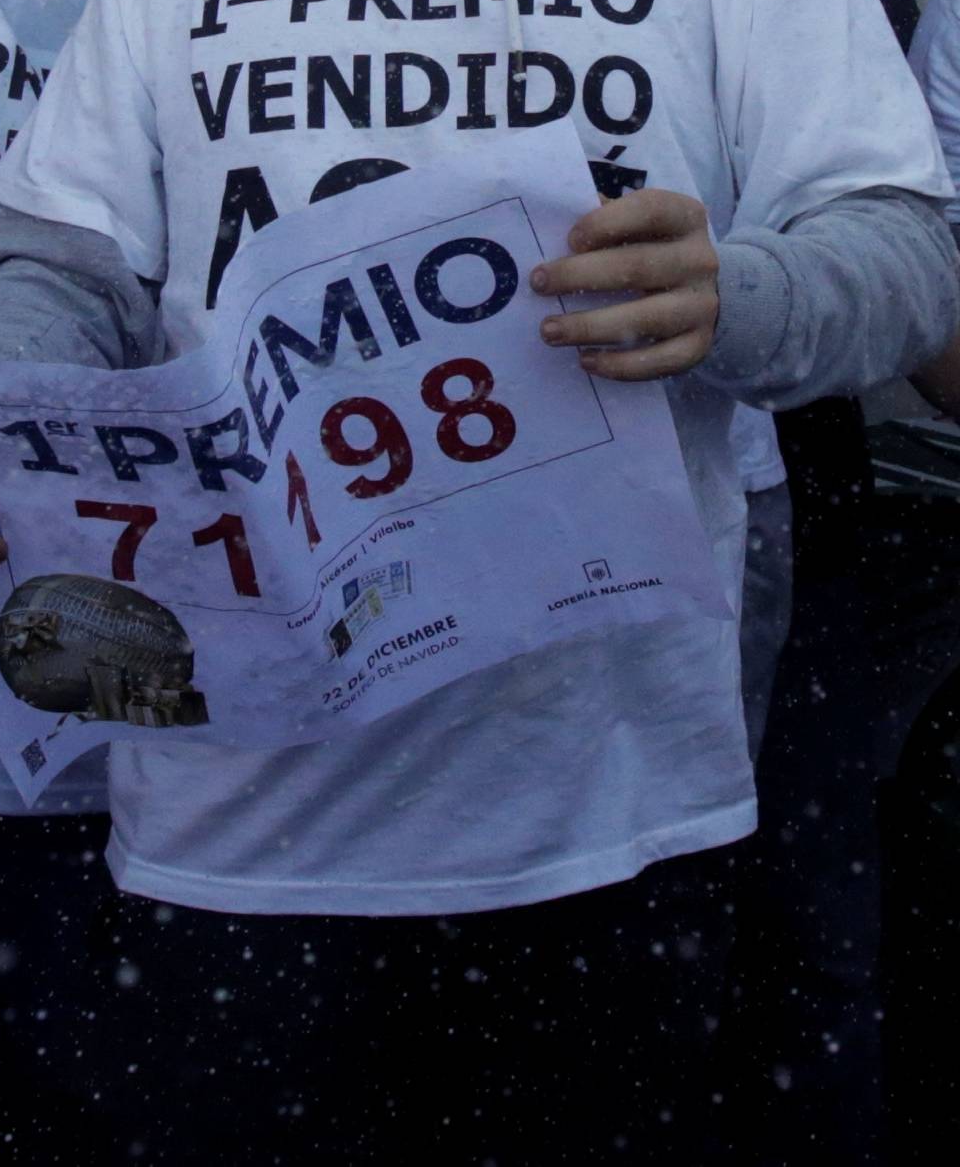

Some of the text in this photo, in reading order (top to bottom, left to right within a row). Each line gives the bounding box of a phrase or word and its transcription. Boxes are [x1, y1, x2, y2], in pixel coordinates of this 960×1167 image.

[190, 50, 654, 142] VENDIDO
[92, 236, 520, 492] PREMIO
[369, 518, 416, 545] Vilalba
[547, 577, 664, 612] LOTERÍA NACIONAL
[347, 667, 368, 691] DE
[366, 614, 459, 670] DICIEMBRE
[377, 663, 395, 679] DE
[397, 635, 460, 671] NAVIDAD
